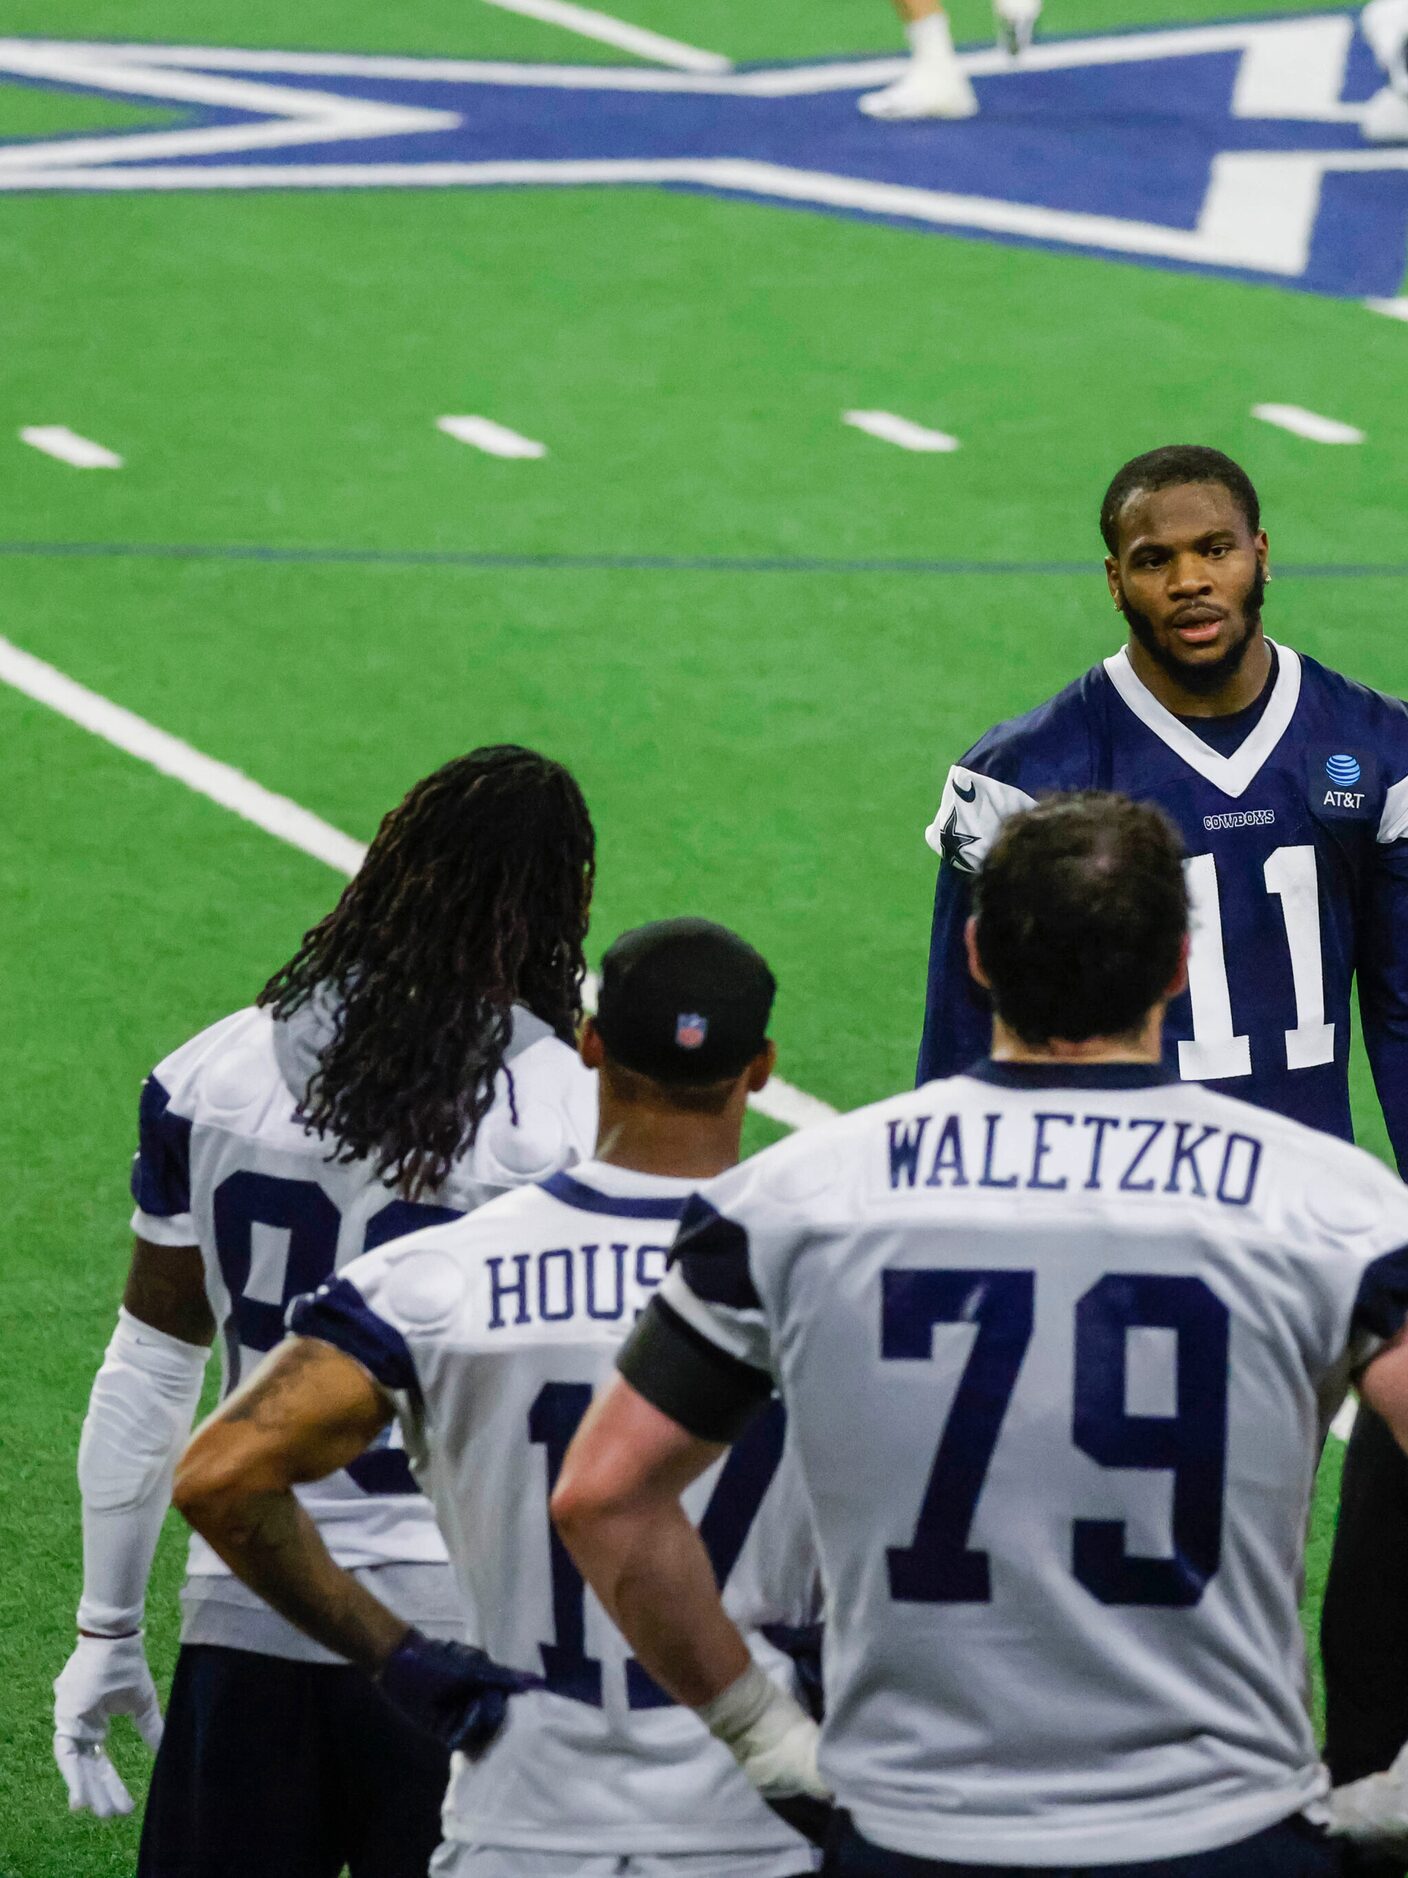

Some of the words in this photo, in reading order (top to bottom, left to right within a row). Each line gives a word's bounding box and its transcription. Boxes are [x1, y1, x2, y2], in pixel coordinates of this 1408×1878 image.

[1203, 809, 1275, 831] COWBOYS
[1323, 790, 1365, 809] AT&T
[1178, 844, 1336, 1081] 11
[886, 1112, 1263, 1206] WALETZKO
[880, 1268, 1230, 1608] 79
